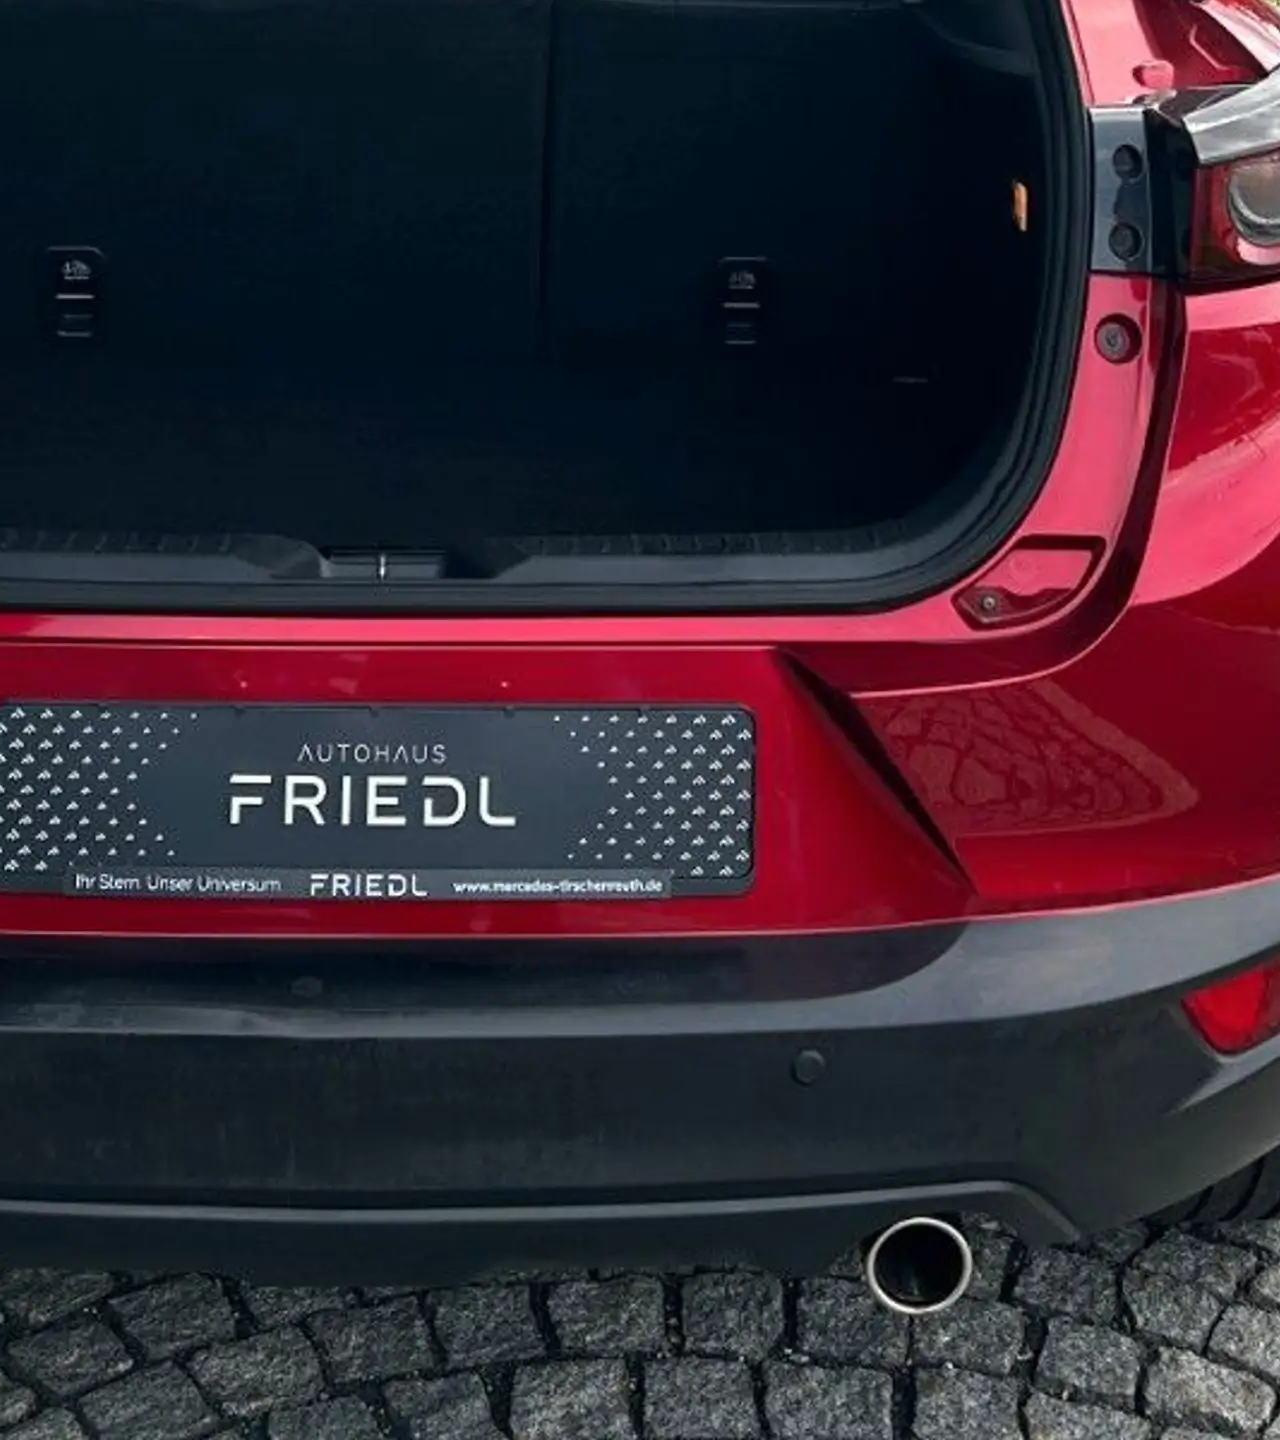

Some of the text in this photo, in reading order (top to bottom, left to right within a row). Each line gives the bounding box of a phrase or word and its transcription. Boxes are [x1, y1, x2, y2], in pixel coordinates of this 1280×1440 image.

[297, 743, 448, 763] AUTOHAUS
[229, 774, 517, 826] FRIEDL
[75, 873, 95, 889] Ihr
[147, 874, 194, 891] Unser
[198, 875, 282, 892] Universum
[310, 873, 427, 896] FRIEDL
